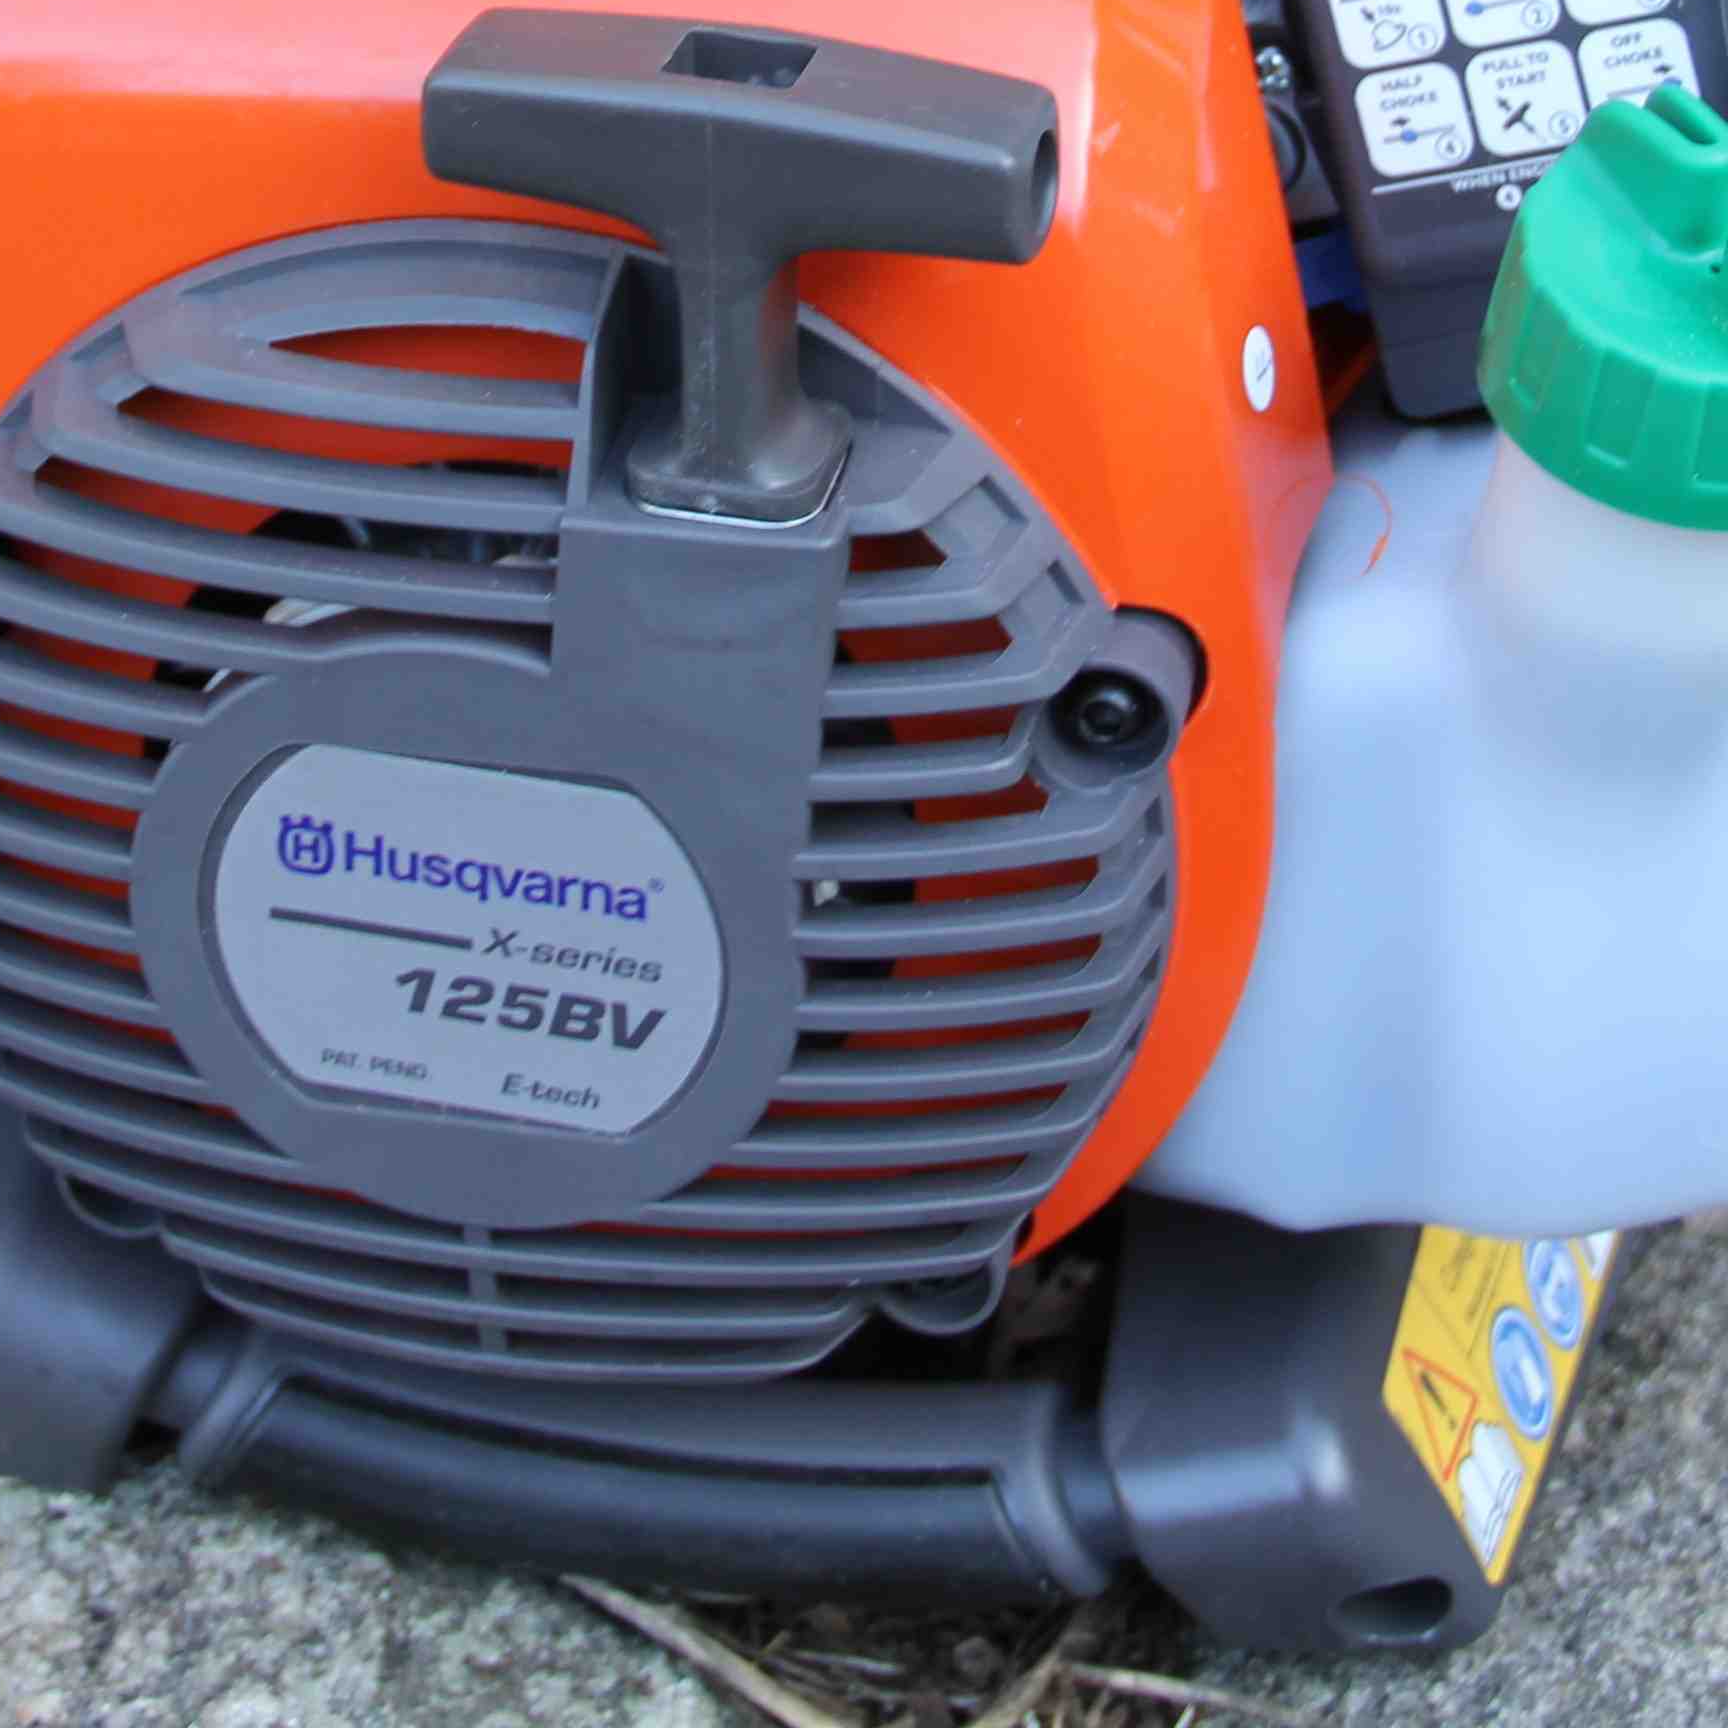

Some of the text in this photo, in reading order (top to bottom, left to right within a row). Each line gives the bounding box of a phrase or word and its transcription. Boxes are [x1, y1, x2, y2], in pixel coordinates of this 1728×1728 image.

[1609, 31, 1643, 49] OFF
[1480, 50, 1550, 73] PULL TO
[1602, 47, 1664, 70] CHOKE
[1380, 74, 1423, 93] HALF
[1495, 70, 1548, 90] START
[1379, 90, 1439, 112] CHOKE
[1451, 170, 1506, 192] WHEN
[481, 926, 663, 985] X-series
[394, 967, 668, 1052] 125BV
[499, 1071, 602, 1111] E-tech
